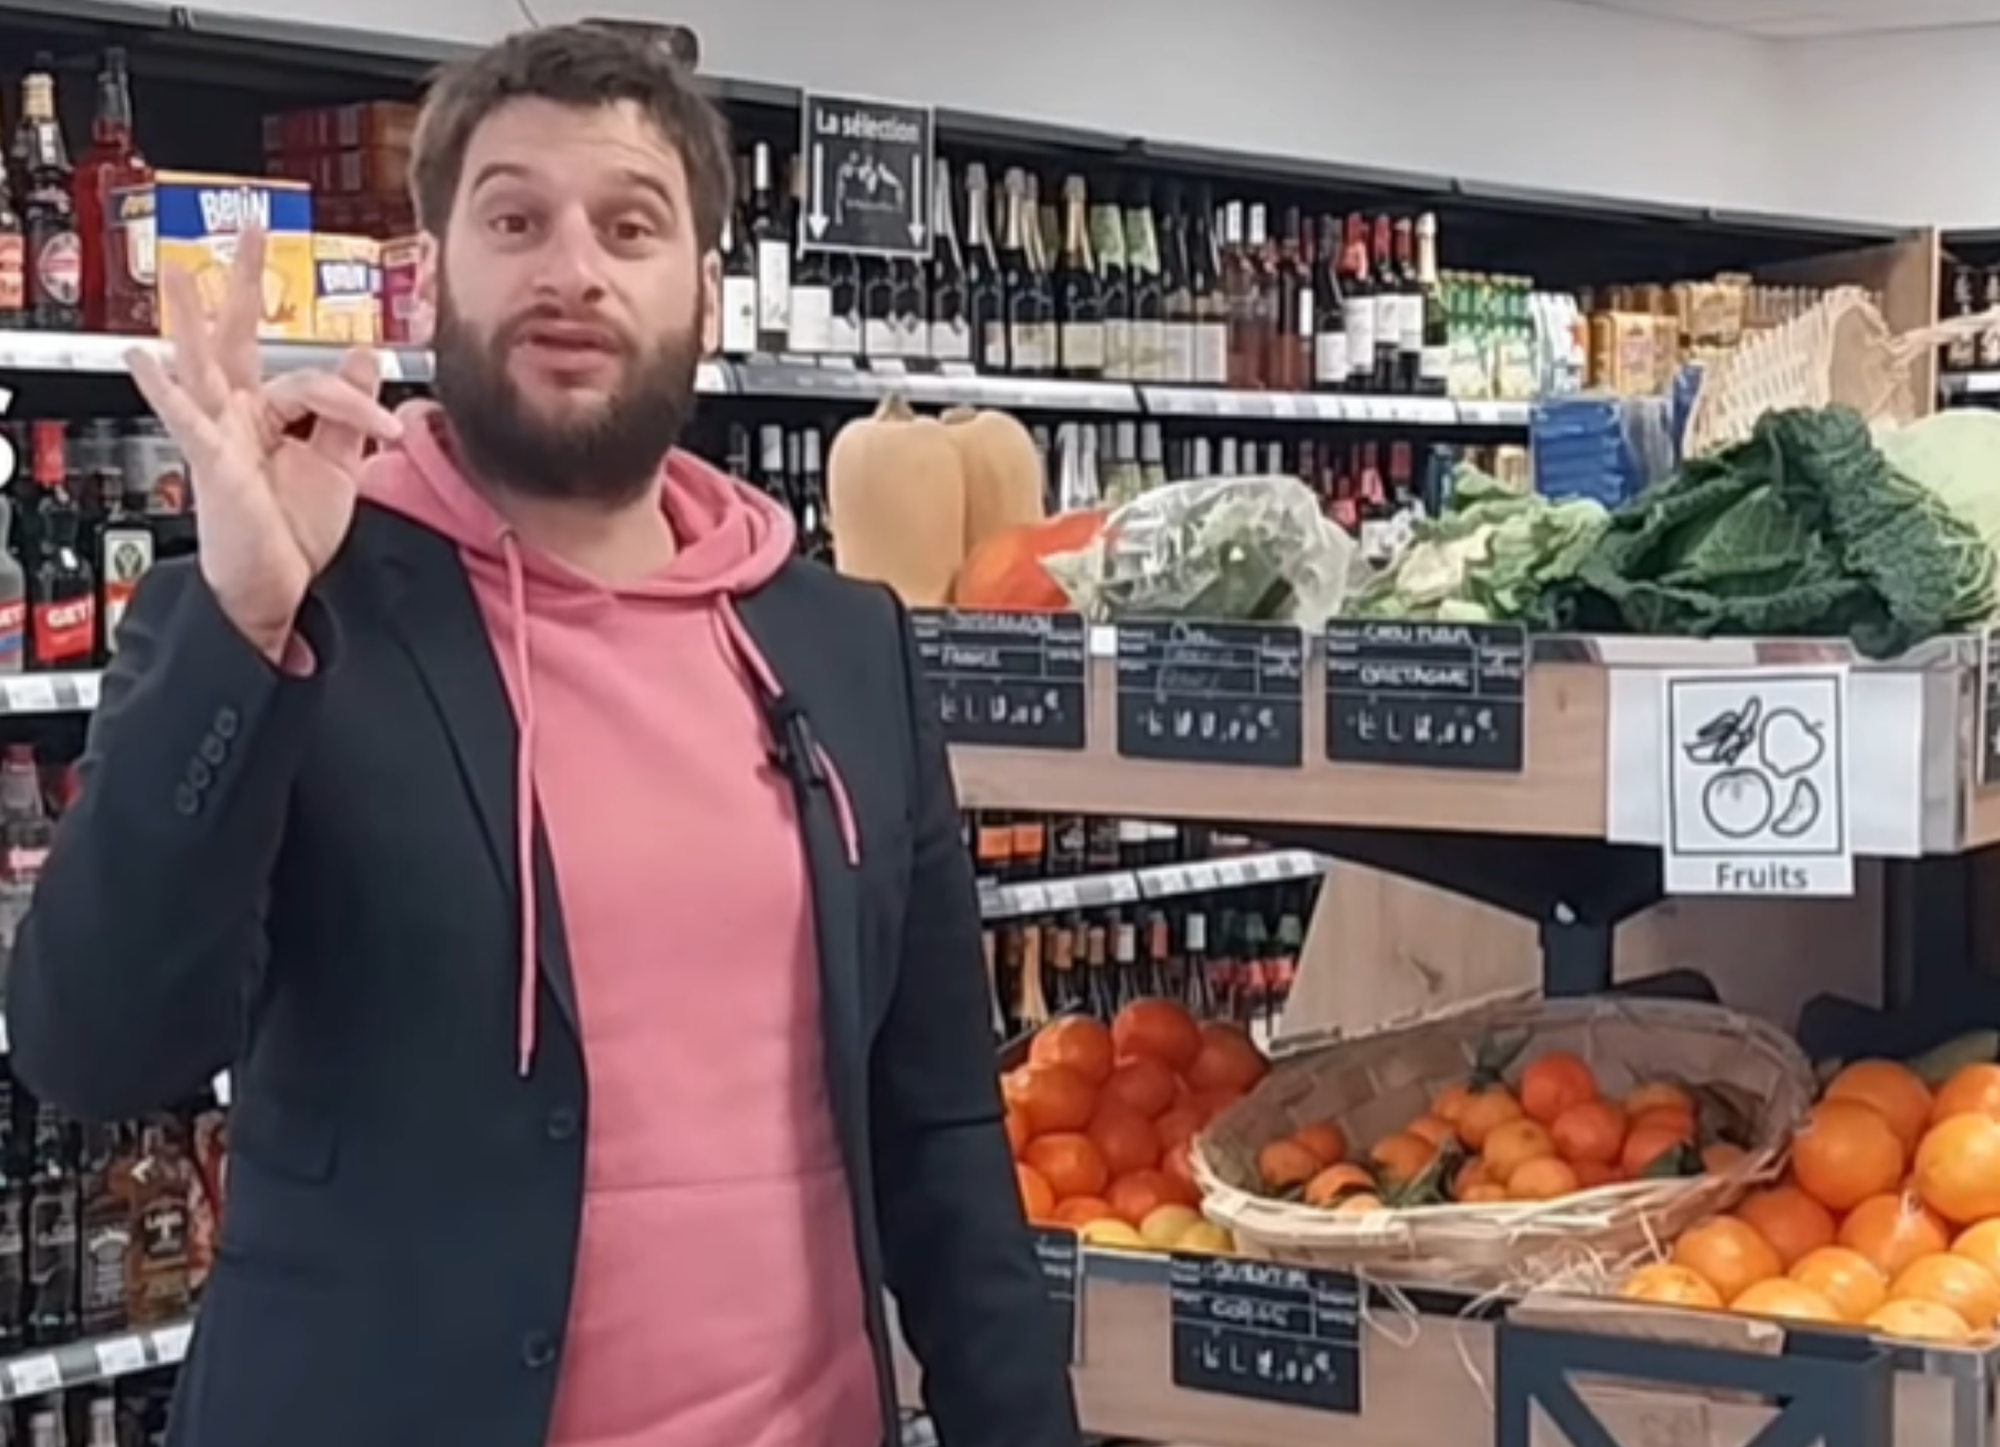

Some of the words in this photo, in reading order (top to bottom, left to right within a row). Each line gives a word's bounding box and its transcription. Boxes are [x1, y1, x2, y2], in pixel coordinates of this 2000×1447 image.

[815, 106, 839, 135] La
[841, 110, 920, 144] sélection
[1715, 860, 1810, 891] Fruits
